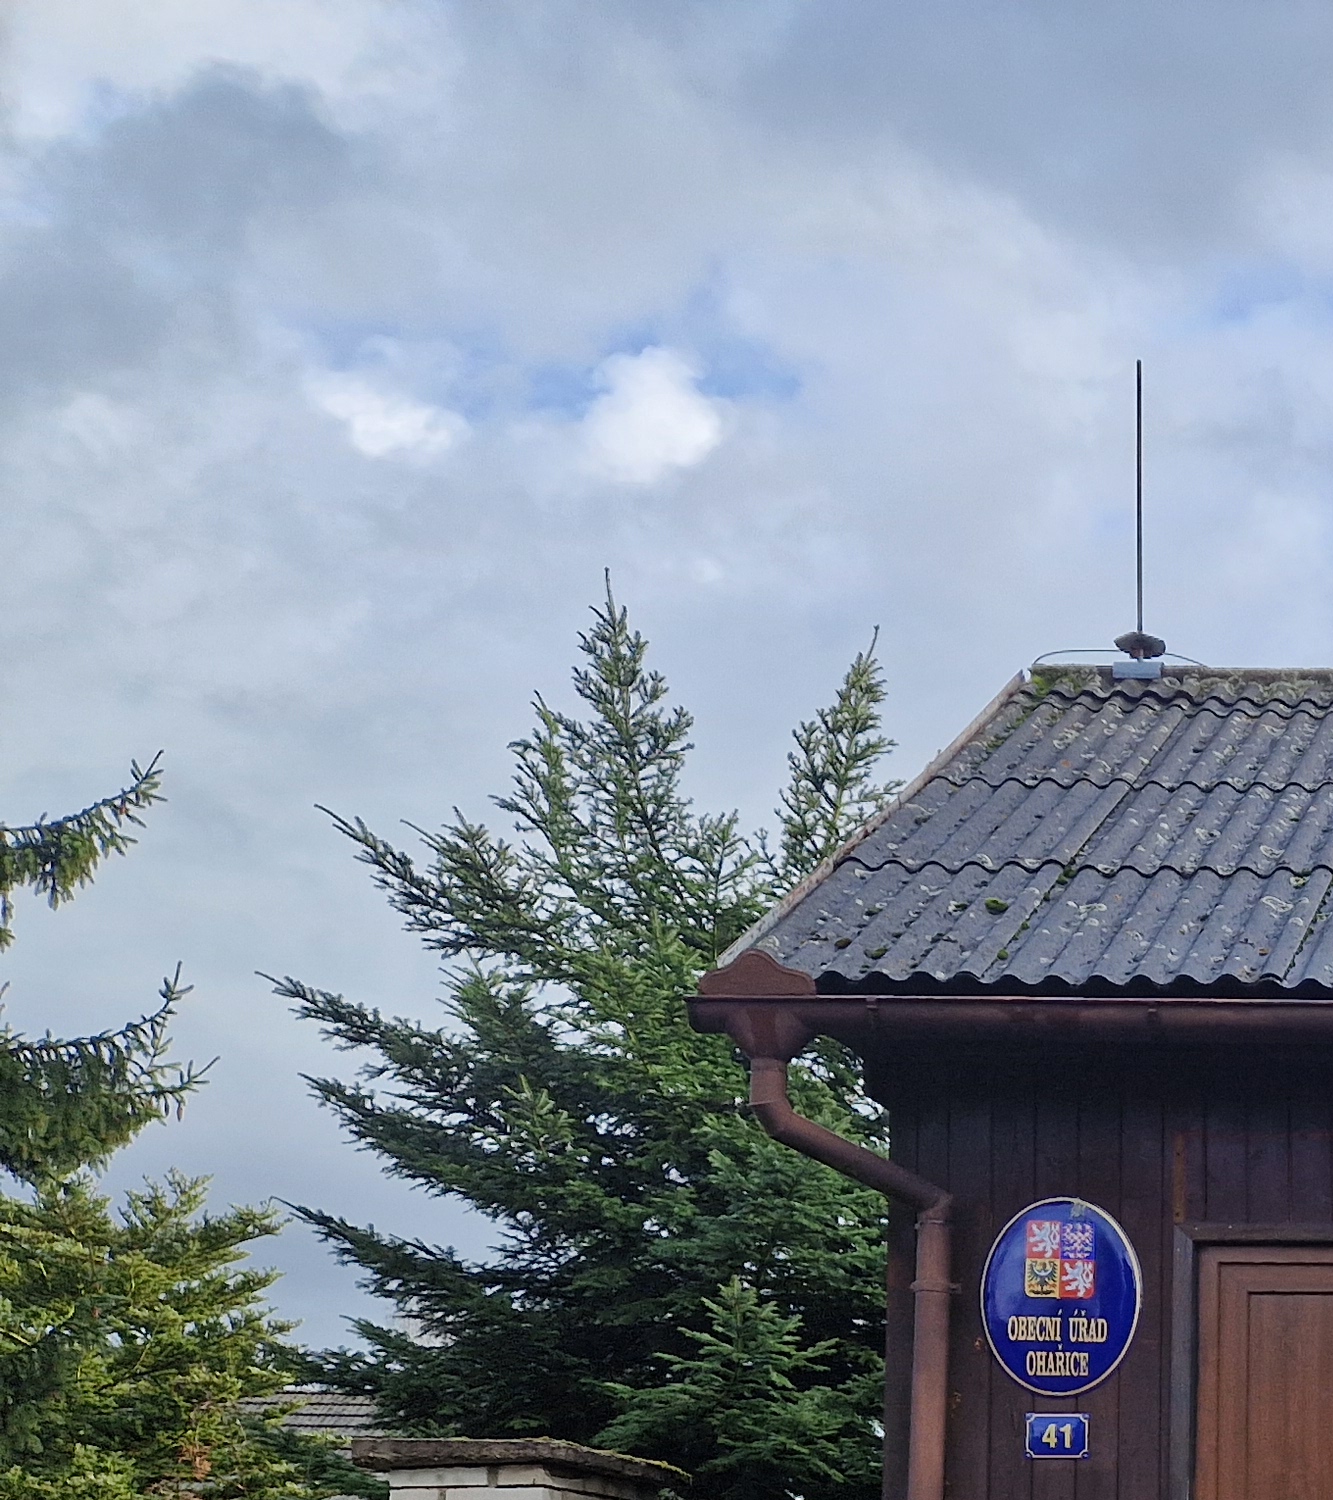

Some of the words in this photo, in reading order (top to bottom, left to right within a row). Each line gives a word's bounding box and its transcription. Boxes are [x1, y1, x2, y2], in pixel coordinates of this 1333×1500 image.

[1008, 1308, 1062, 1341] OBECNÍ
[1068, 1308, 1108, 1342] ÚŘAD
[1026, 1343, 1089, 1377] OHAŘICE
[1041, 1423, 1071, 1449] 41
